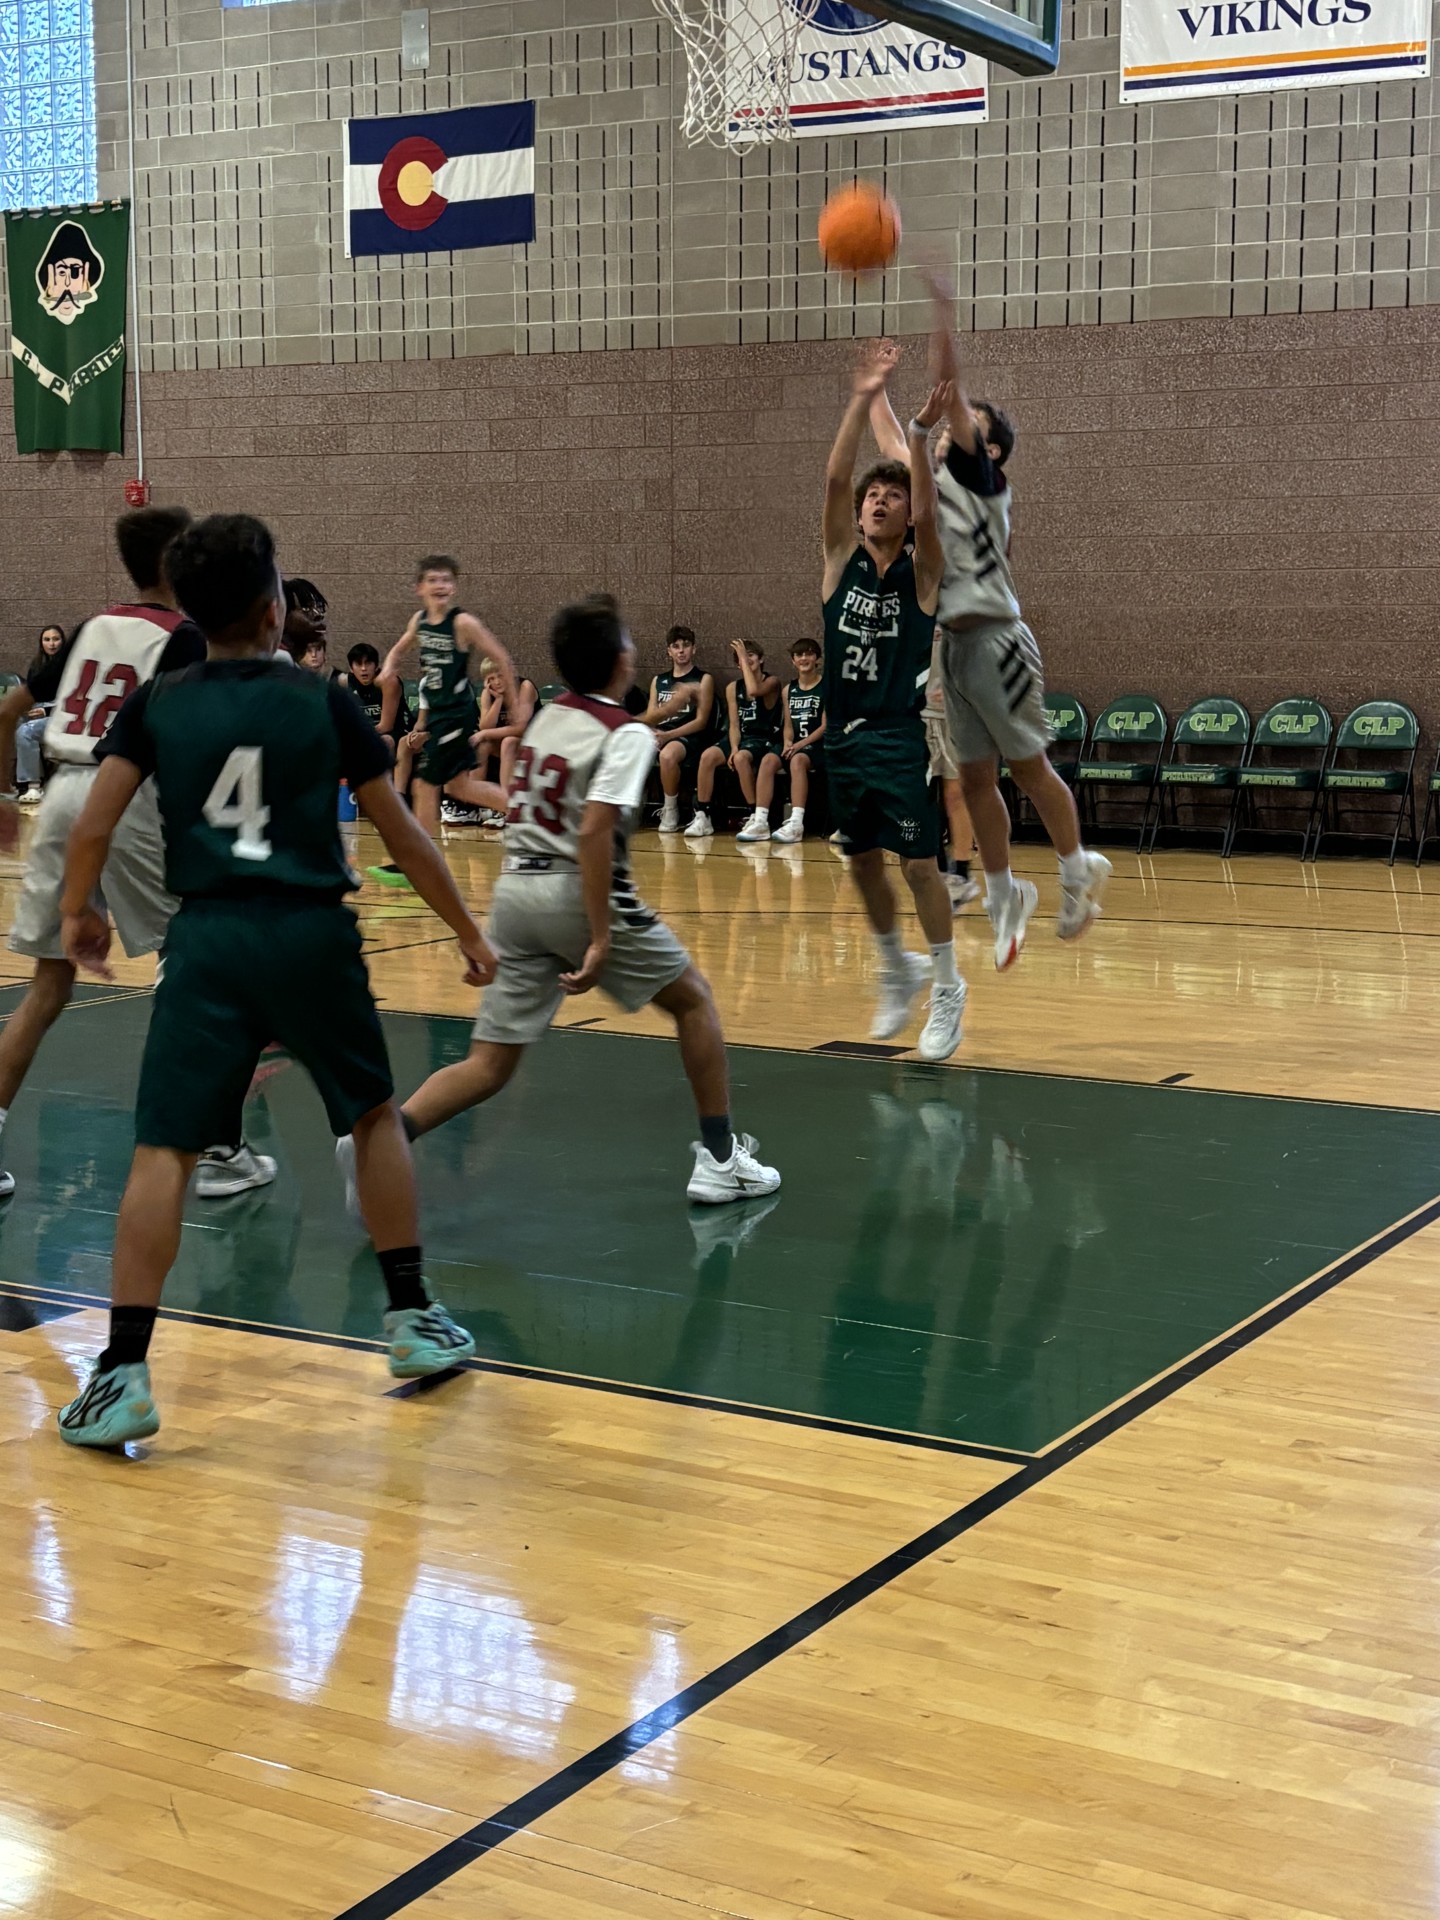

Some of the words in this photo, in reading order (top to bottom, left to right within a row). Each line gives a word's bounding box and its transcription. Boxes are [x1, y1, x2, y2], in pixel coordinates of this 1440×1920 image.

[1177, 0, 1371, 39] VIKINGS
[750, 40, 967, 86] MUSTANGS
[21, 347, 66, 393] CP
[841, 645, 878, 682] 24
[64, 659, 138, 738] 42
[799, 721, 809, 738] 5
[1107, 711, 1155, 730] CLP
[1189, 713, 1238, 732] CLP
[1269, 714, 1319, 734] CLP
[1353, 716, 1405, 736] CLP
[202, 745, 273, 862] 4
